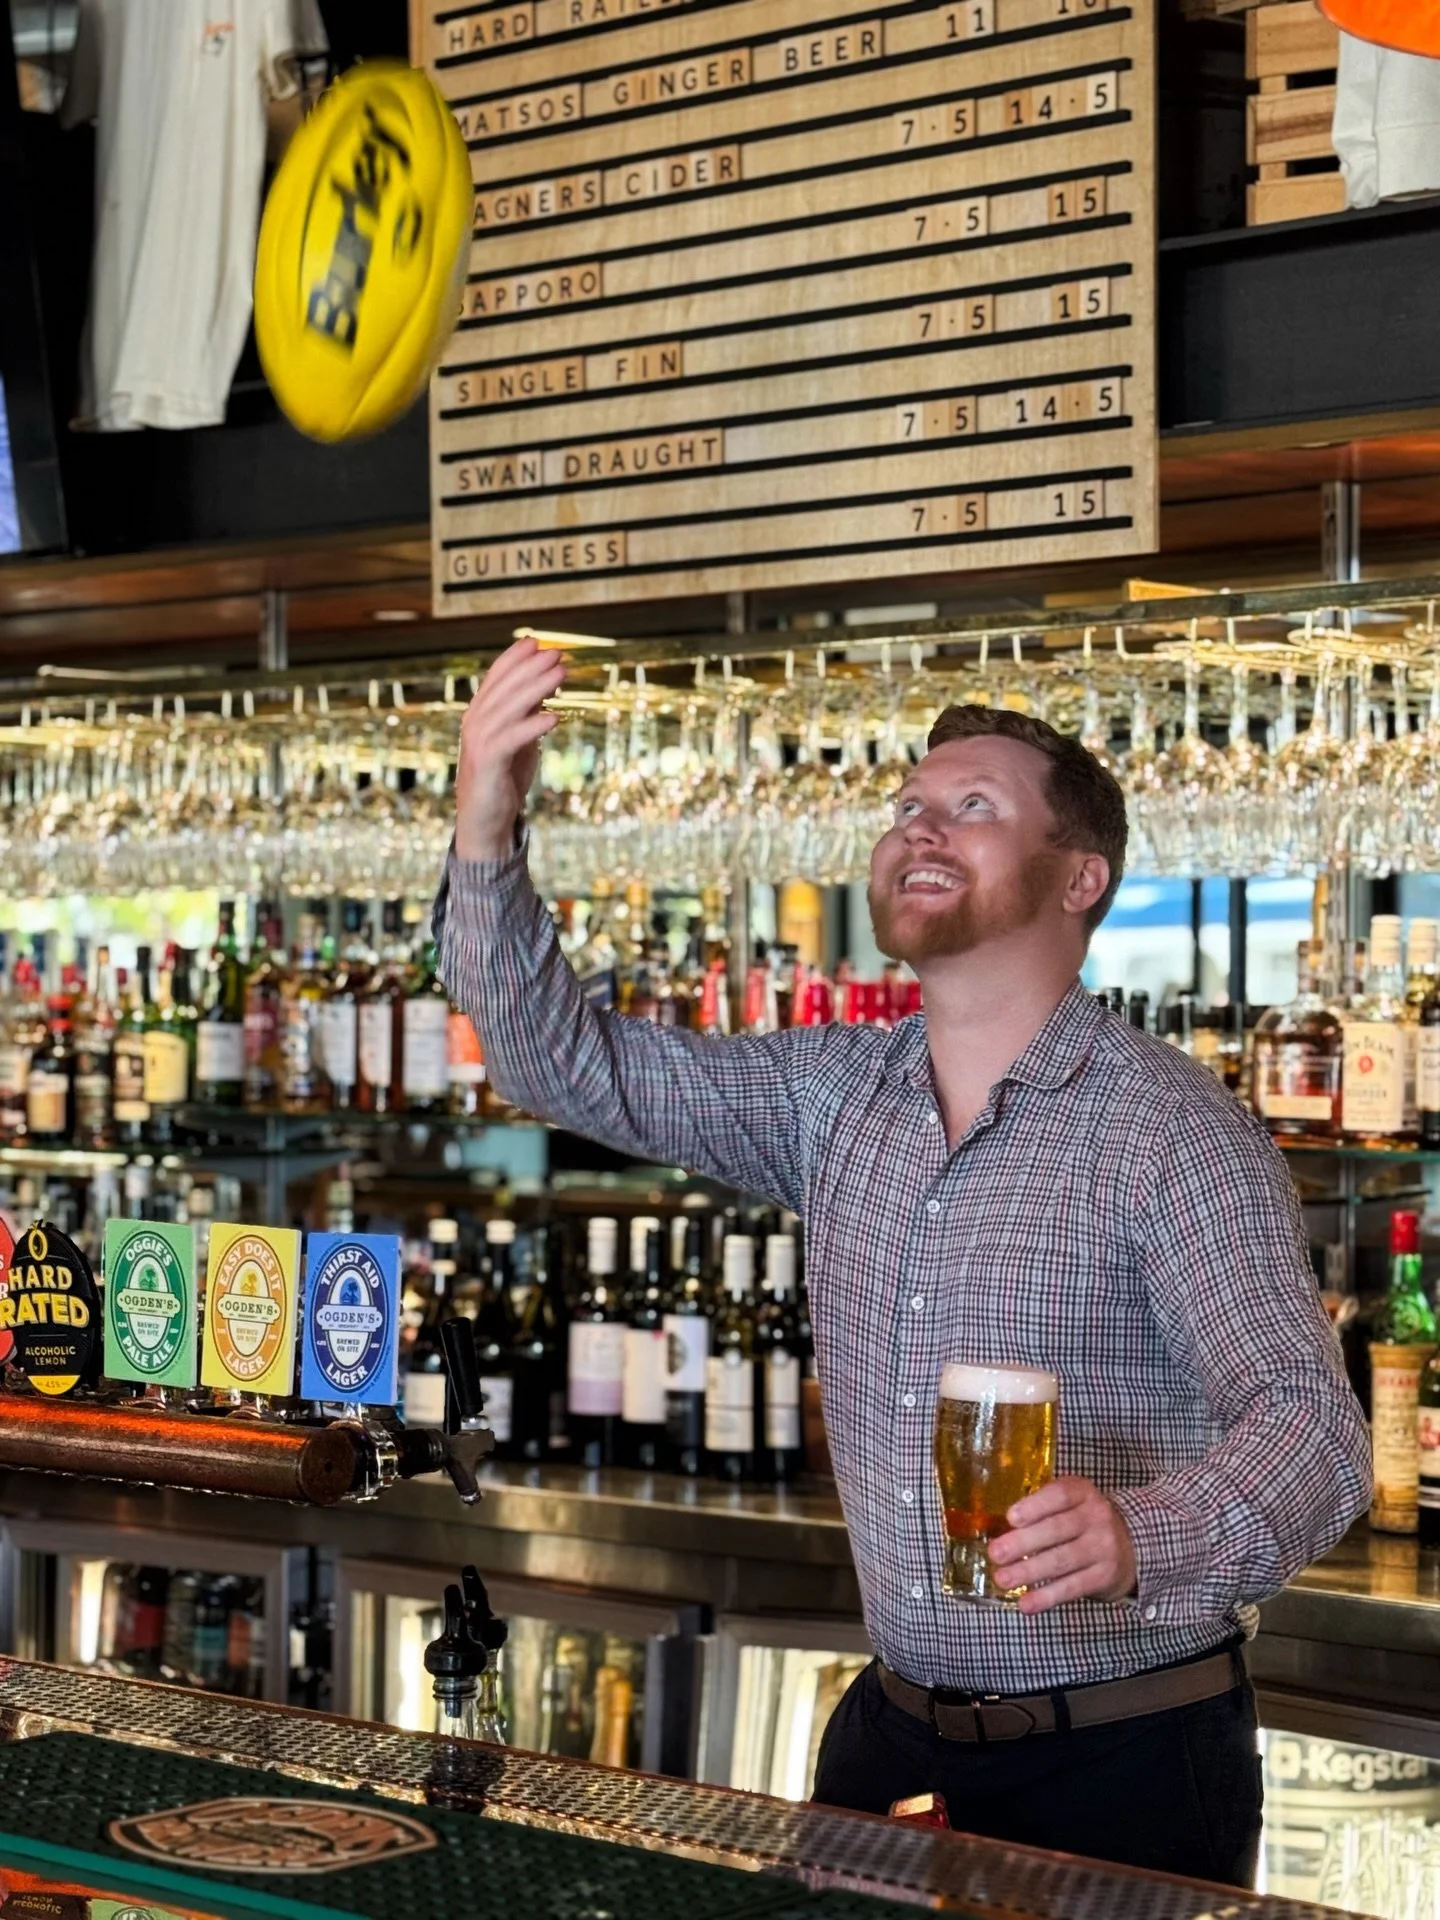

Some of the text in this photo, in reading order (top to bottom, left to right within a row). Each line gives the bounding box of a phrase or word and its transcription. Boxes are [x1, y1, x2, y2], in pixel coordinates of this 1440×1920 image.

[450, 14, 529, 50] HARD
[613, 59, 744, 105] GINGER
[784, 31, 875, 71] BEER
[946, 7, 985, 39] 11
[472, 181, 595, 225] AGNERS
[625, 156, 733, 195] CIDER
[1055, 188, 1097, 217] 15
[458, 366, 578, 402] SINGLE
[616, 350, 678, 381] FIN
[1059, 289, 1101, 318] 15
[458, 460, 537, 490] SWAN
[565, 438, 718, 478] DRAUGHT
[454, 540, 619, 577] GUINNESS
[1054, 491, 1095, 516] 15
[126, 1237, 173, 1267] OGGIE'S
[218, 1247, 242, 1287] EASY
[244, 1242, 274, 1272] DOES
[270, 1272, 282, 1290] IT
[8, 1265, 73, 1291] HARD
[321, 1250, 362, 1286] THIRST
[362, 1259, 380, 1290] AID
[0, 1292, 90, 1331] RATED
[124, 1295, 174, 1310] OGDEN'S
[224, 1300, 274, 1316] OGDEN'S
[324, 1311, 375, 1324] OGDEN'S
[25, 1346, 76, 1356] ALCOHOLIC
[123, 1335, 149, 1368] PALE
[152, 1339, 174, 1367] ALE
[336, 1338, 360, 1347] BREWED
[35, 1356, 66, 1366] LEMON
[226, 1351, 266, 1375] LAGER
[326, 1363, 368, 1386] LAGER
